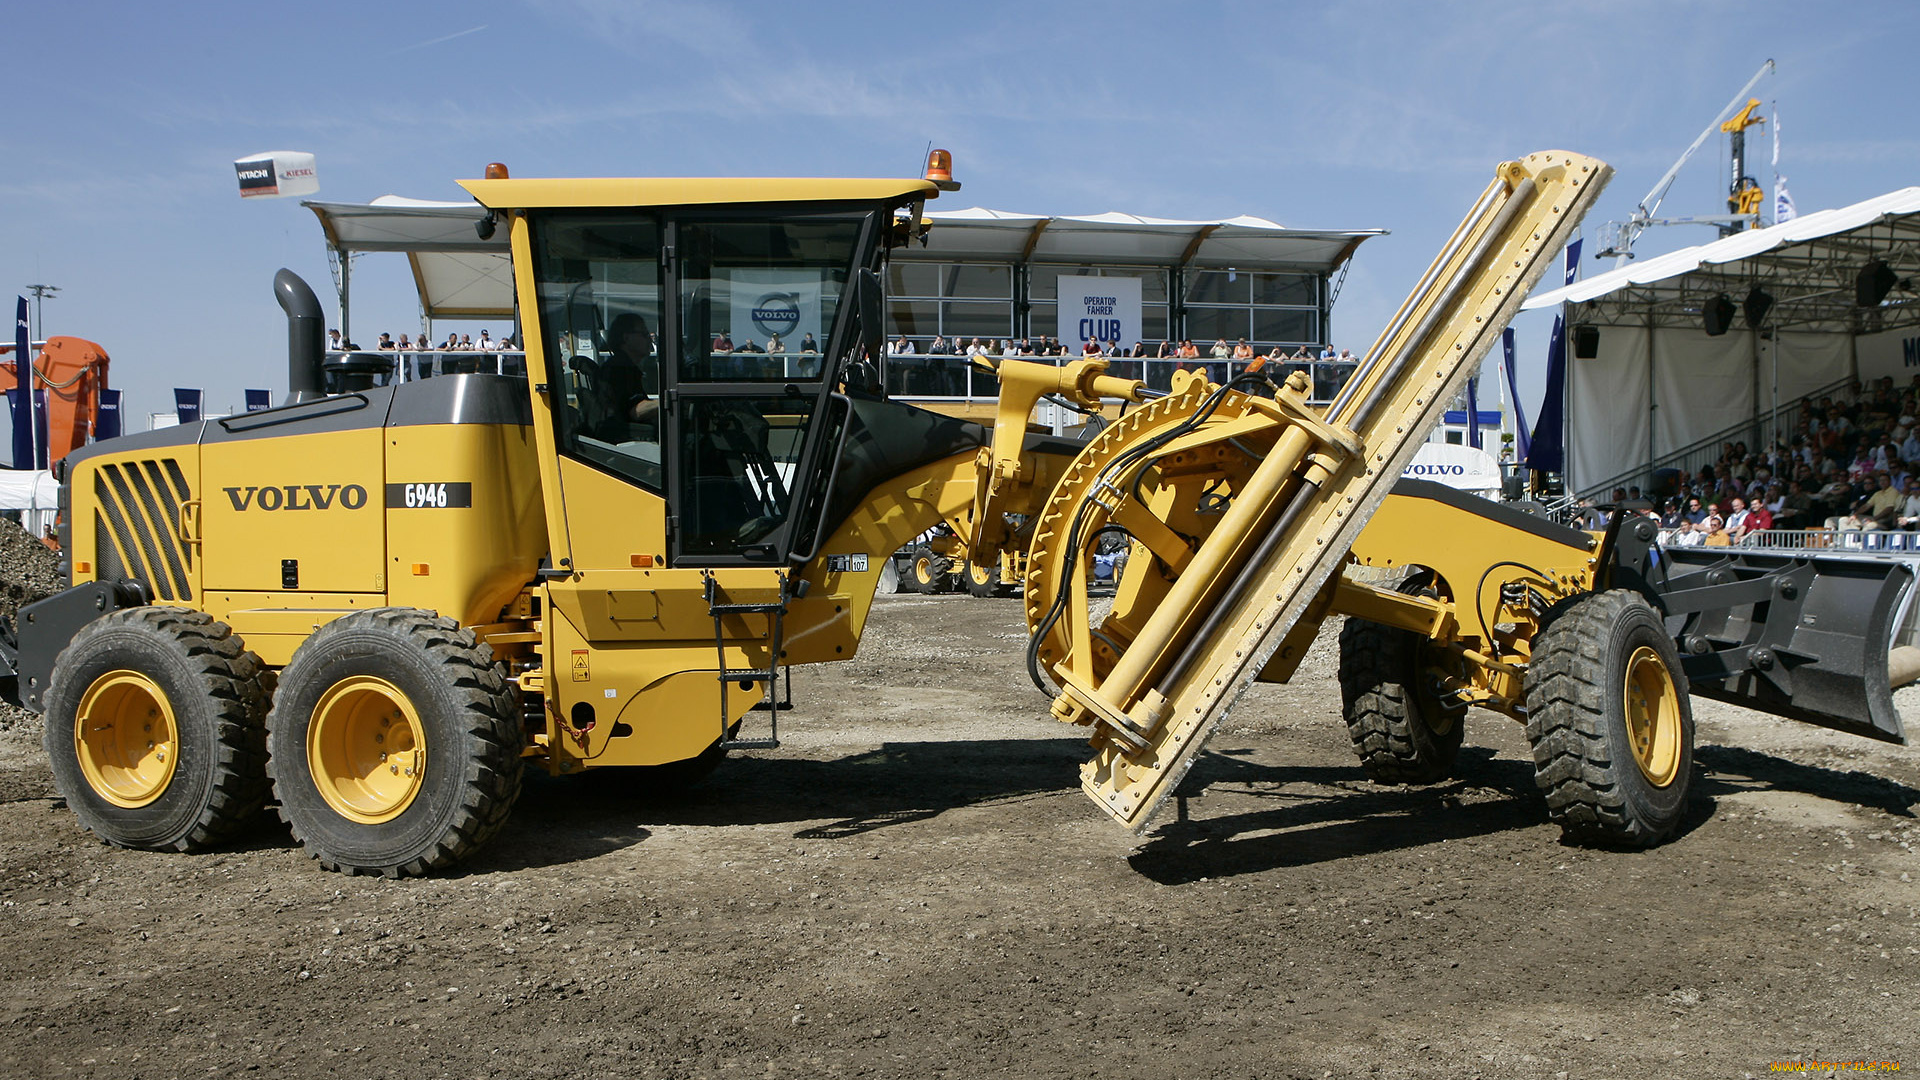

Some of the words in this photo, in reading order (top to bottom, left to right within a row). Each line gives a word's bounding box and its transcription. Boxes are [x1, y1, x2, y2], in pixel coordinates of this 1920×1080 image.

[238, 169, 268, 180] HITACHI
[286, 169, 313, 177] KIESEL
[1083, 296, 1117, 306] OPERATOR
[754, 311, 797, 319] VOLVO
[1087, 306, 1113, 316] FAHRER
[1079, 318, 1121, 342] CLUB
[1902, 336, 1920, 368] M
[222, 484, 368, 512] VOLVO
[404, 483, 448, 509] G946
[853, 561, 866, 571] 107
